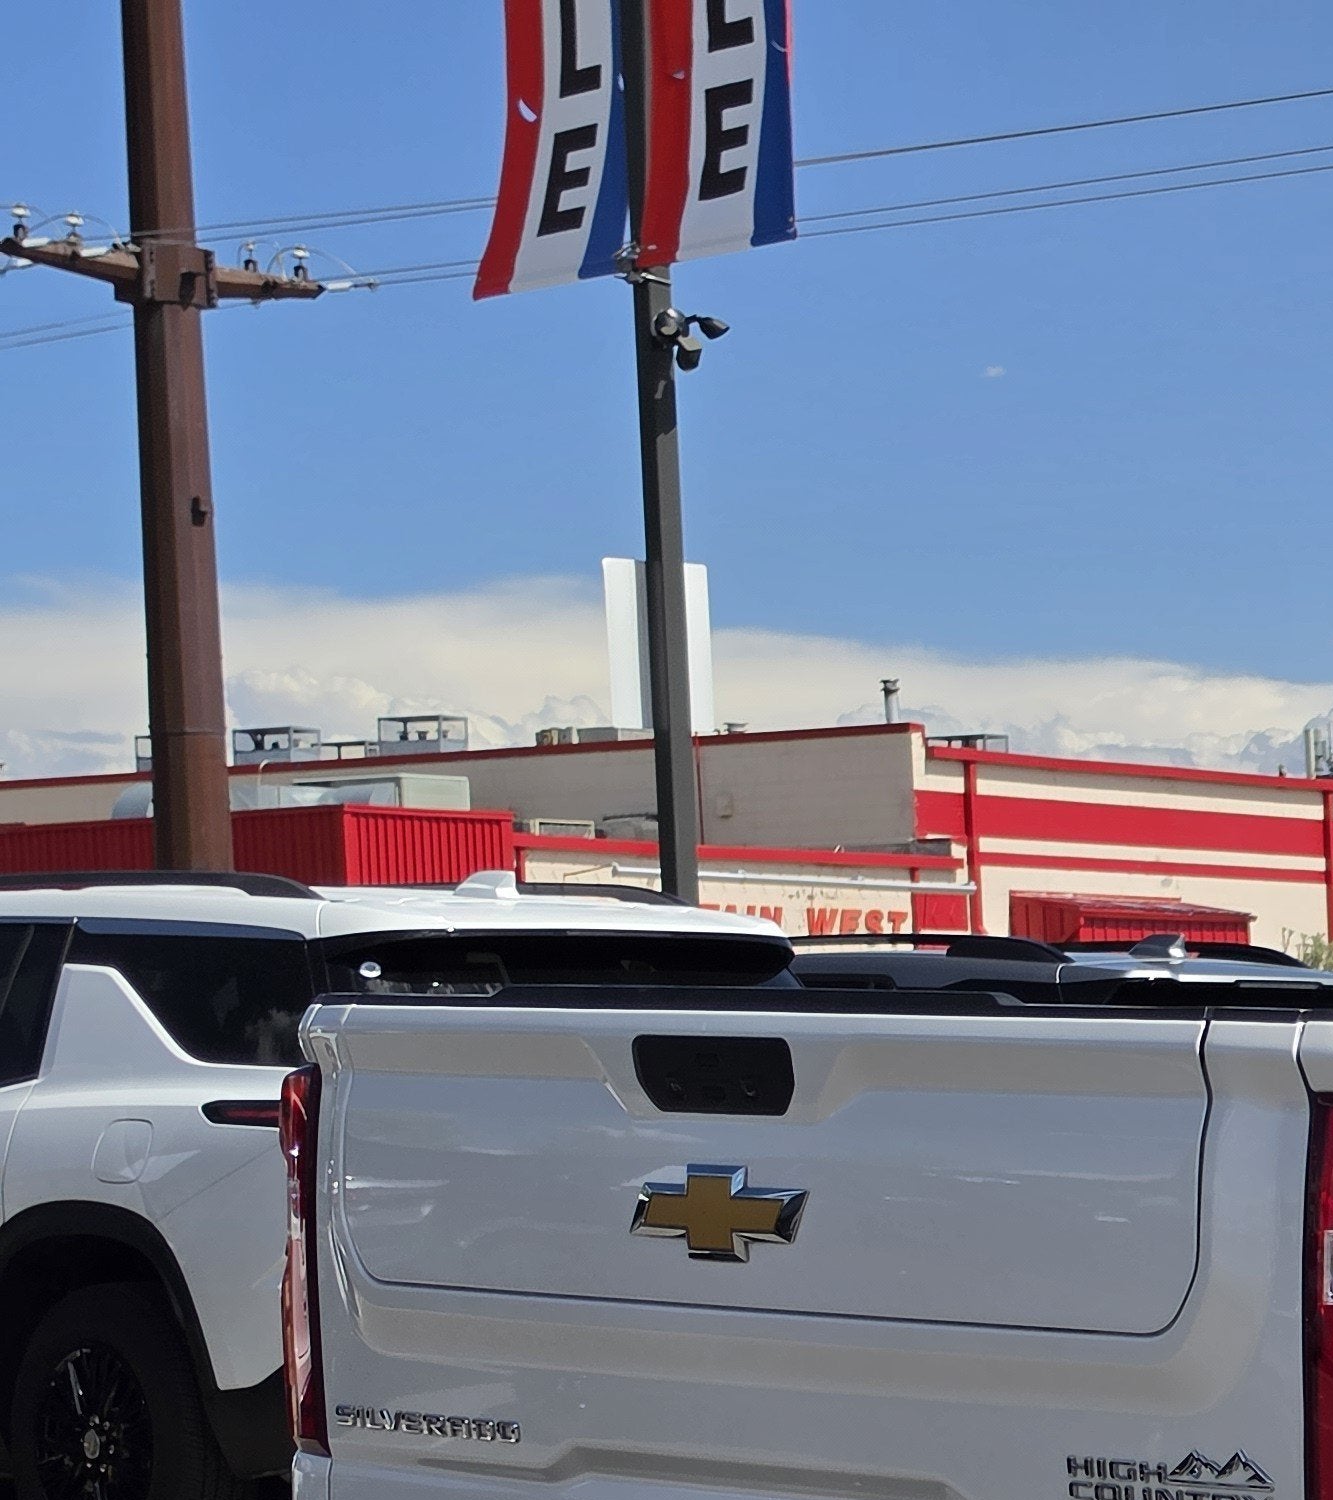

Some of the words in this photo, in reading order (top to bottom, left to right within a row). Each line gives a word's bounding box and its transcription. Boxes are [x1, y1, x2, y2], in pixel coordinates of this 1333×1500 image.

[806, 907, 909, 936] WEST
[335, 1404, 522, 1444] SILVERADO
[1066, 1454, 1168, 1484] HIGH
